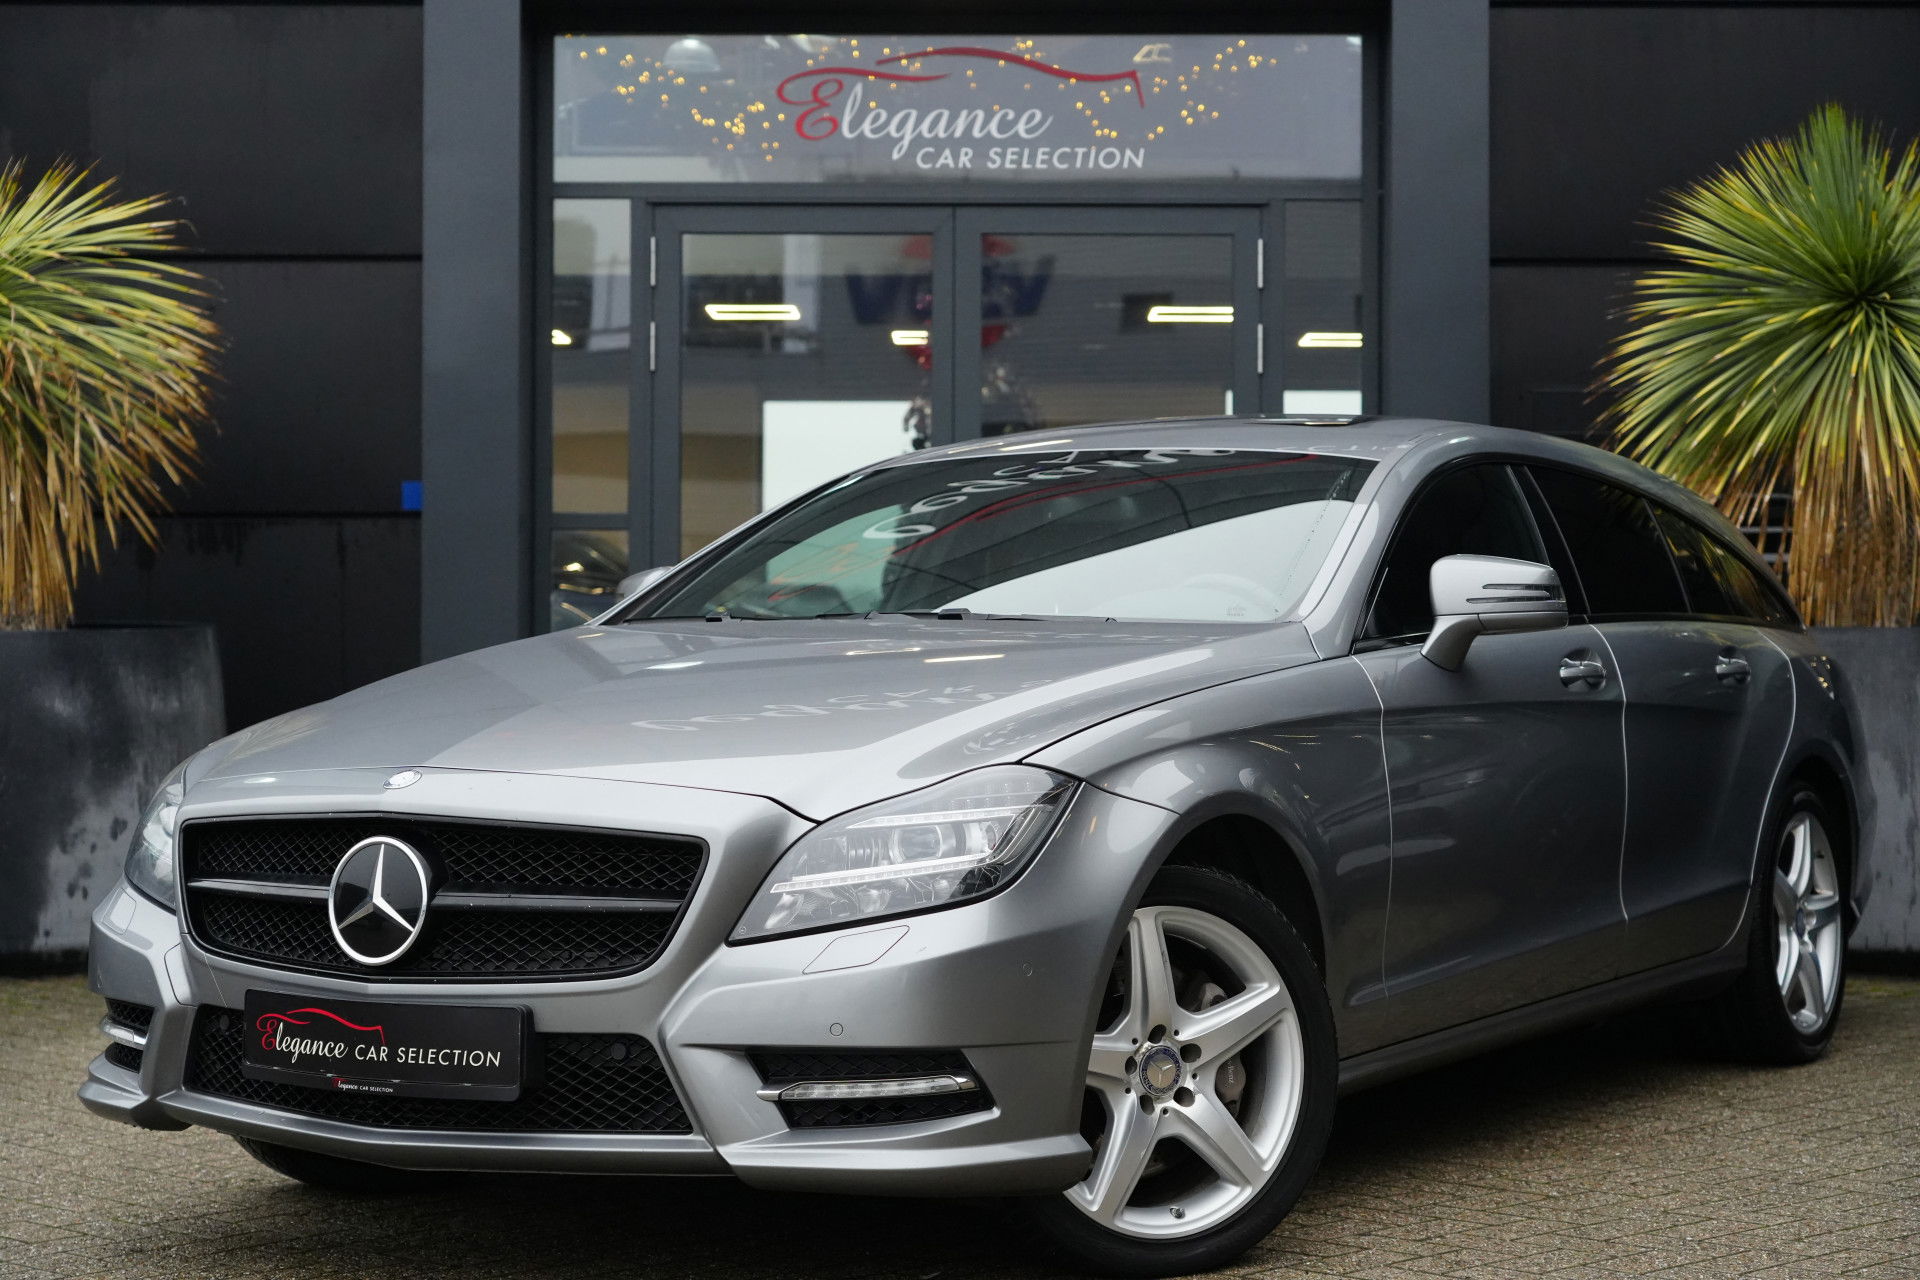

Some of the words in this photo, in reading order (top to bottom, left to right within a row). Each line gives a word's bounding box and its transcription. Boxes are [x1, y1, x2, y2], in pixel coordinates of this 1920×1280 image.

[776, 67, 1054, 160] Elegance
[916, 148, 973, 169] CAR
[987, 148, 1145, 169] SELECTION
[256, 1014, 348, 1063] Elegance
[354, 1044, 388, 1062] CAR
[396, 1047, 501, 1067] SELECTION
